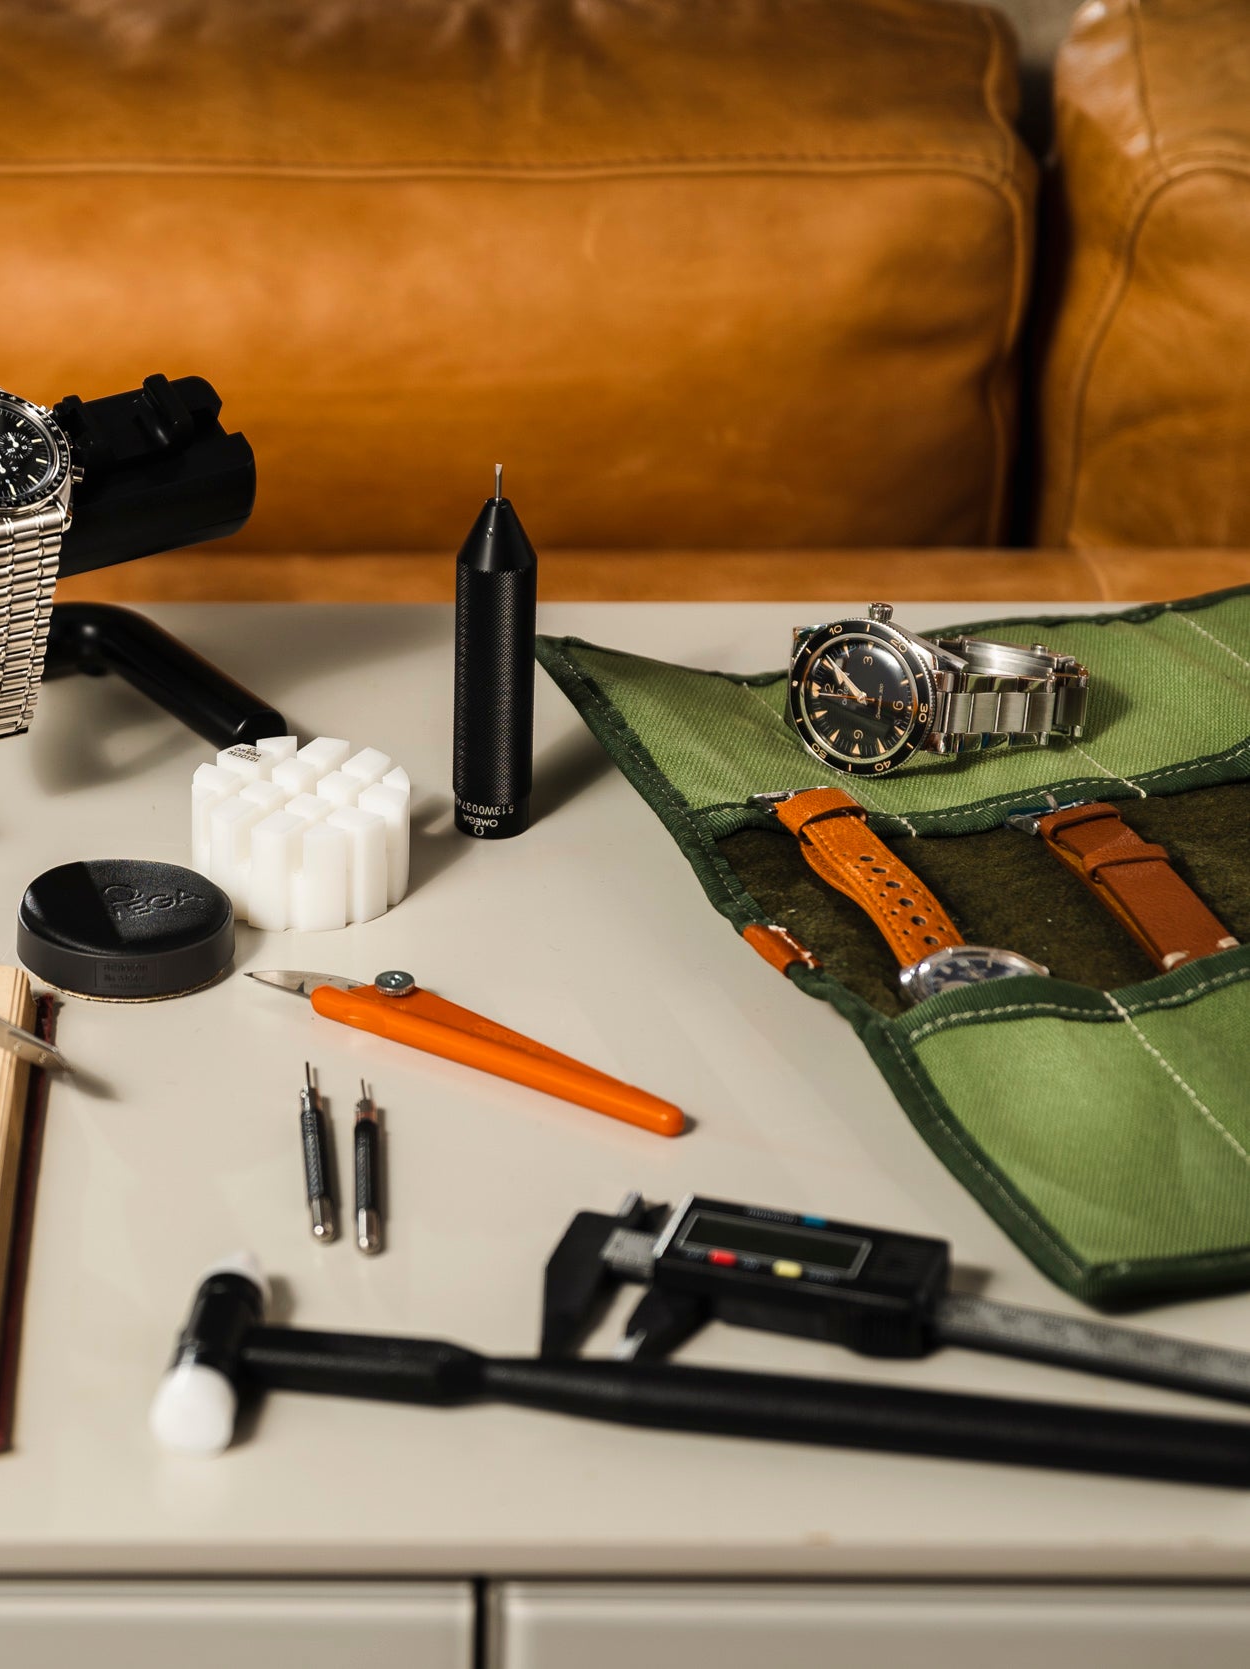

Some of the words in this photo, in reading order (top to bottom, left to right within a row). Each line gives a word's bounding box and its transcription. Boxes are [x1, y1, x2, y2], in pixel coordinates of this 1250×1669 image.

[828, 624, 843, 635] 10
[890, 636, 908, 653] 20
[862, 656, 874, 666] 3
[892, 700, 904, 711] 6
[918, 703, 929, 723] 30
[812, 743, 828, 760] 50
[874, 760, 892, 772] 40
[462, 813, 498, 828] OMEGA
